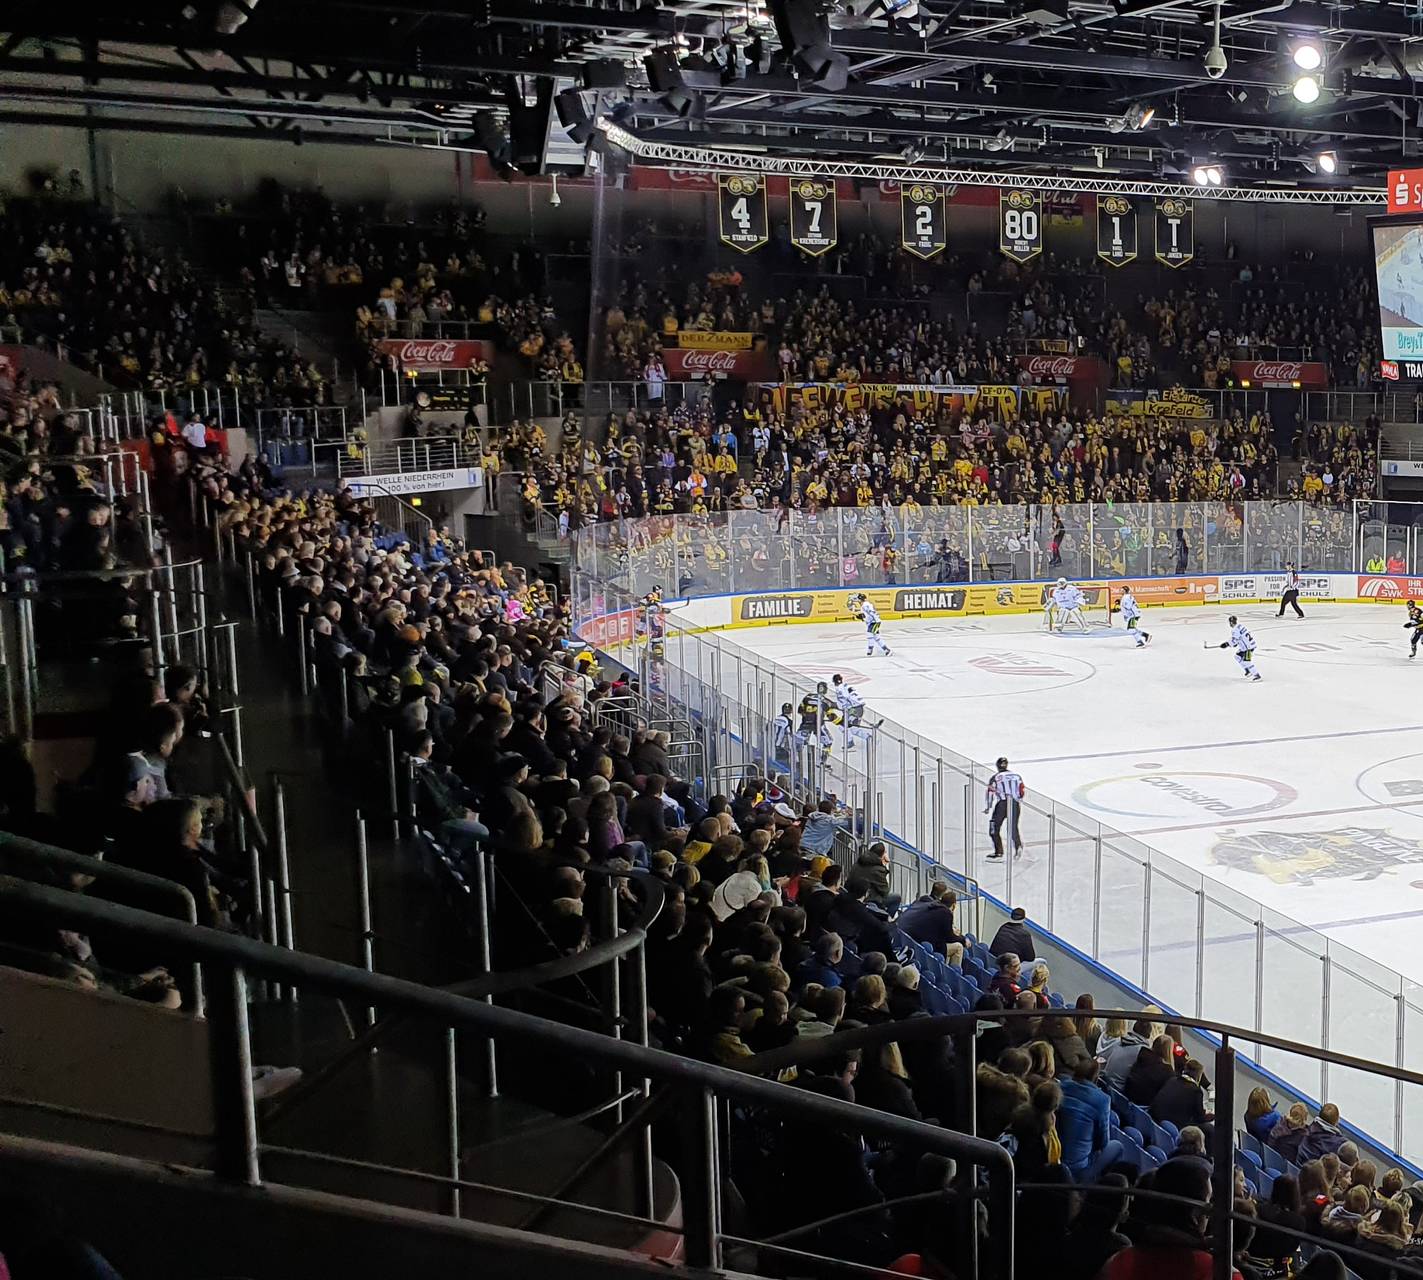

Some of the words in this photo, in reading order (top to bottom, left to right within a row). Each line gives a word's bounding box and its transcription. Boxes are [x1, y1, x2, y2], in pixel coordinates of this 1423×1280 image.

[730, 198, 751, 228] 4
[805, 201, 822, 232] 7
[915, 205, 933, 235] 2
[1005, 209, 1038, 240] 80
[400, 341, 456, 362] Coca-Cola
[682, 351, 739, 370] Coca-Cola
[1028, 356, 1078, 375] Coca-Cola
[1253, 361, 1302, 380] Coca-Cola
[1149, 401, 1195, 416] Krefeld
[376, 475, 402, 485] WELLE
[404, 472, 454, 483] NIEDERRHEIN
[387, 483, 401, 492] 100
[412, 482, 425, 490] von
[1223, 578, 1255, 590] SPC
[1380, 589, 1403, 598] SWK
[749, 598, 805, 618] FAMILIE.
[904, 593, 958, 610] HEIMAT.
